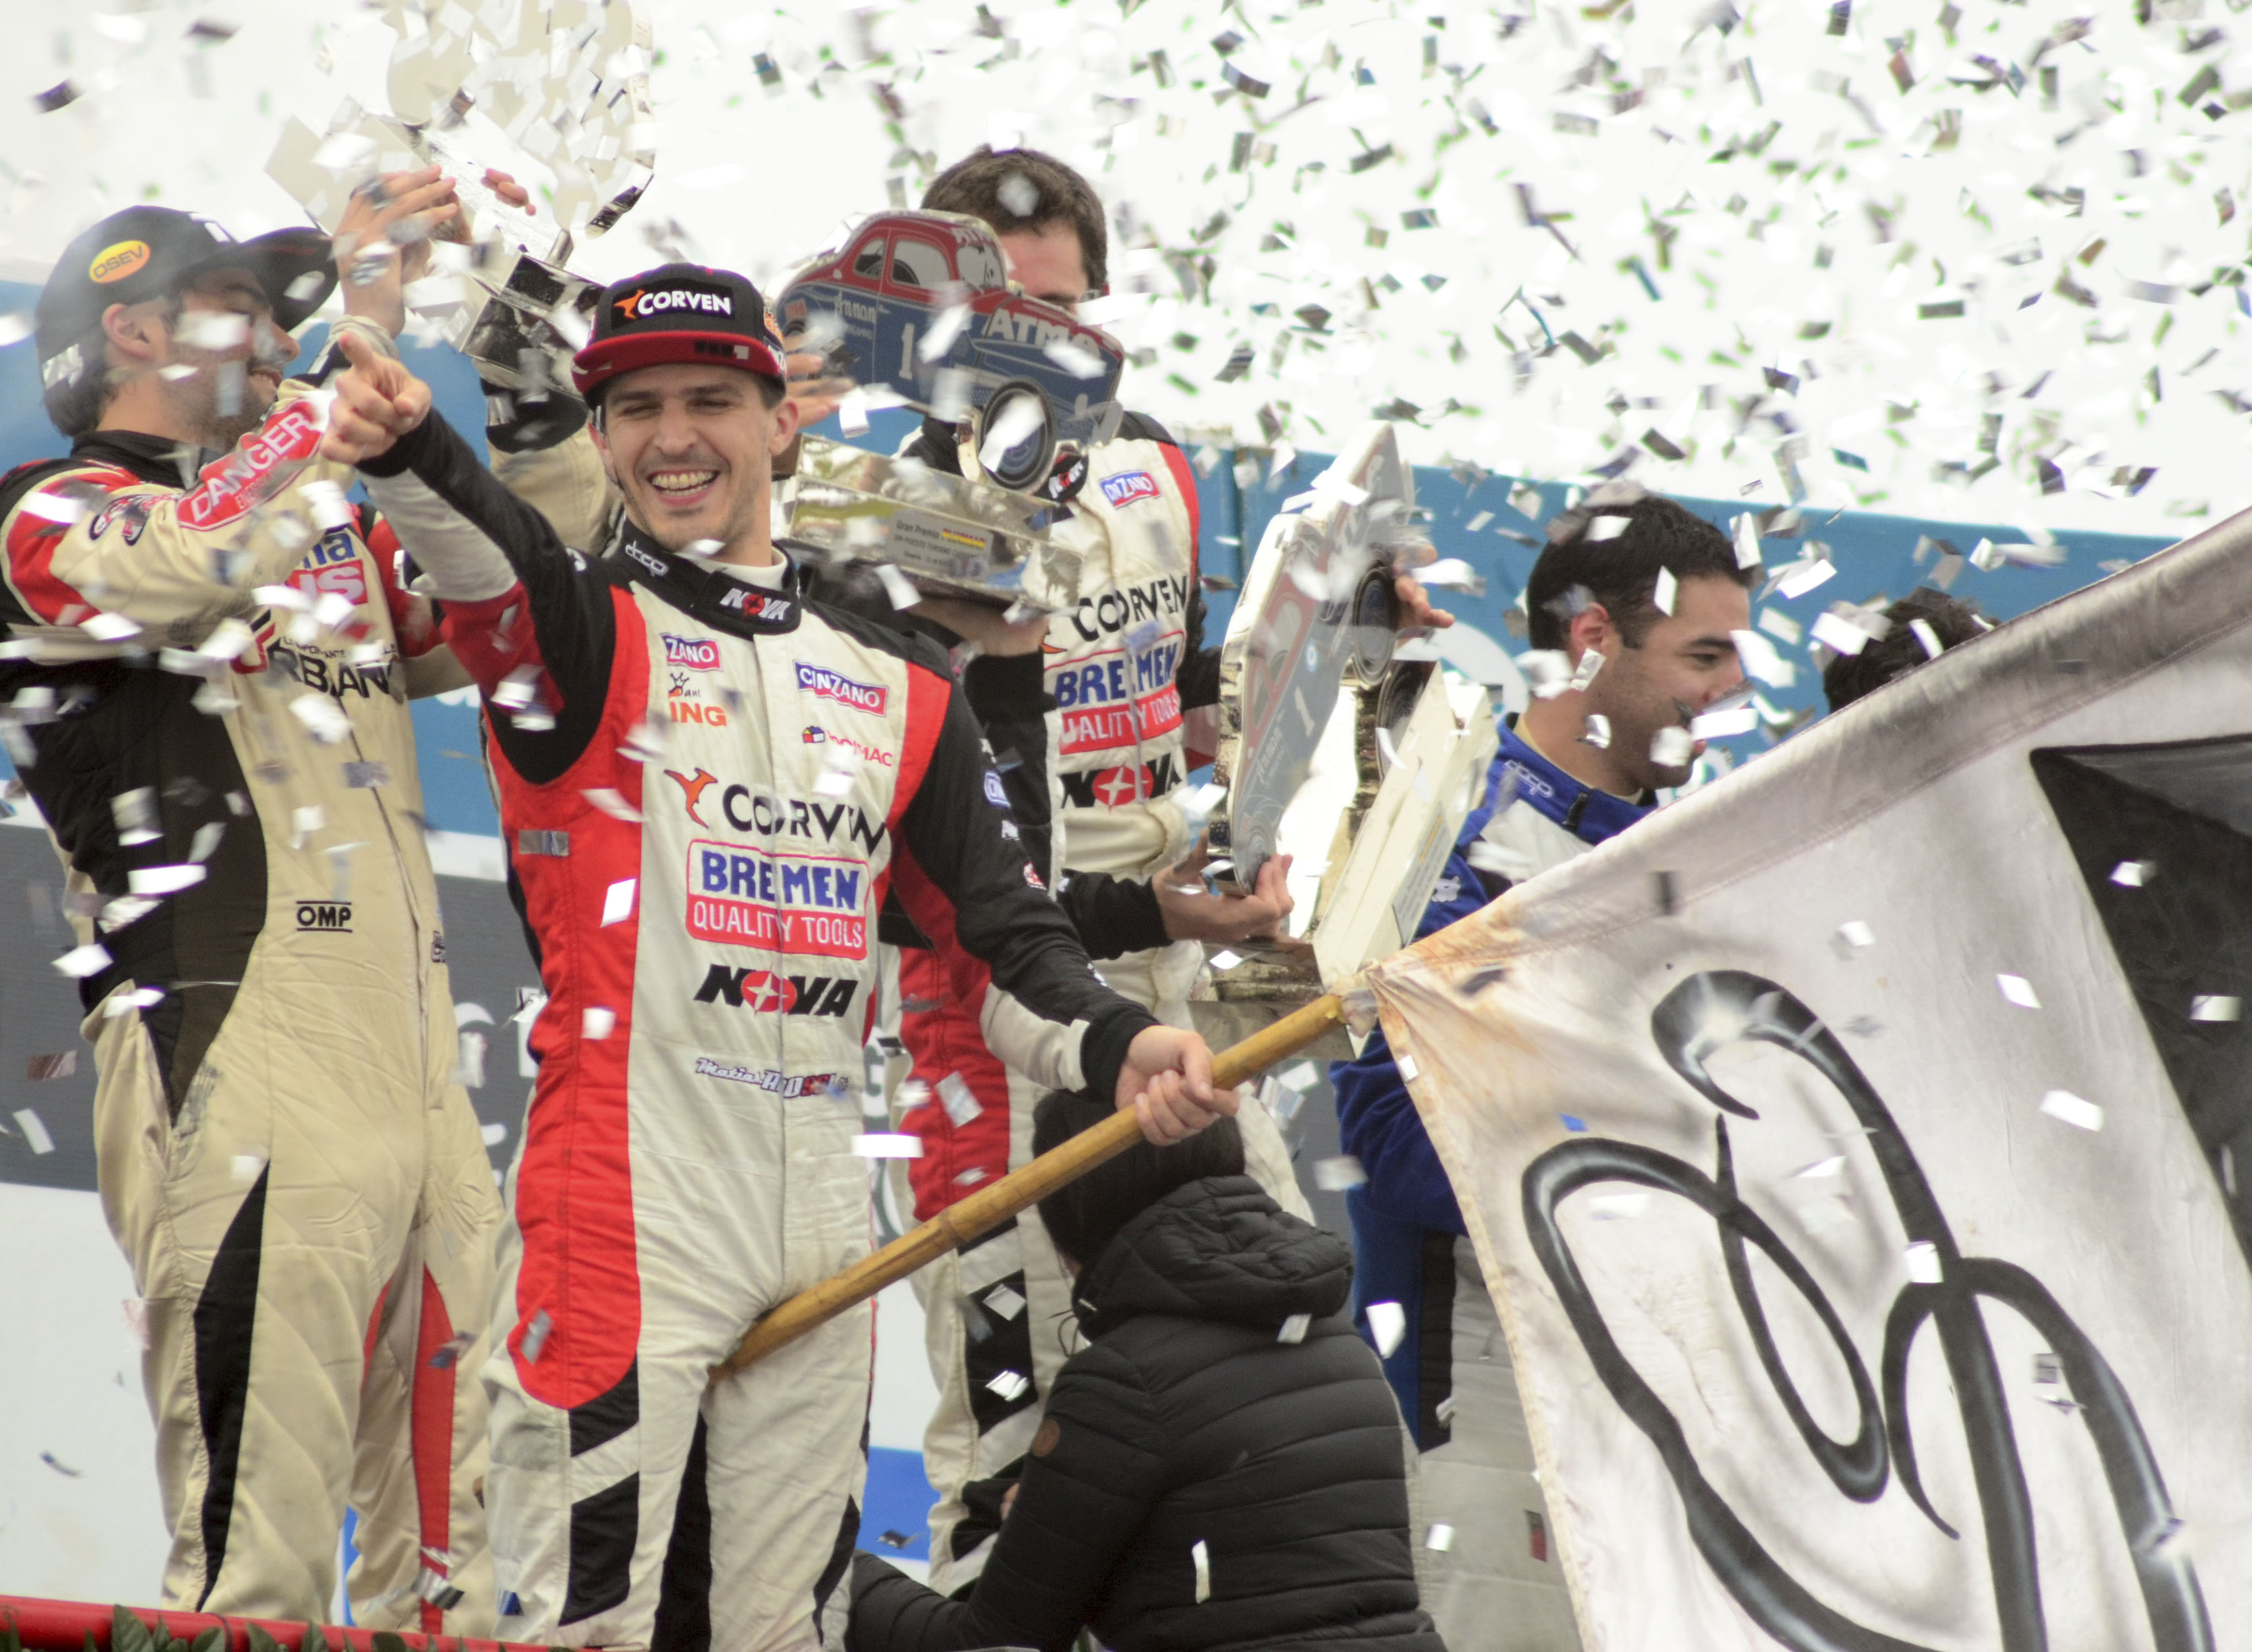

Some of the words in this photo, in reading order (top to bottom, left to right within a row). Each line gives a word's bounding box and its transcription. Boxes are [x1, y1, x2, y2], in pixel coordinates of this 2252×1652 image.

[94, 244, 143, 278] OSEV
[638, 291, 730, 315] CORVEN
[899, 322, 915, 383] 1
[191, 412, 313, 522] DANGER
[1071, 575, 1186, 641] CORVEN
[799, 668, 880, 707] CINZANO
[722, 784, 886, 857] CORVN
[702, 850, 859, 911] BREMEN
[297, 906, 351, 927] OMP
[694, 902, 793, 943] QUALITY
[801, 916, 862, 949] TOOLS
